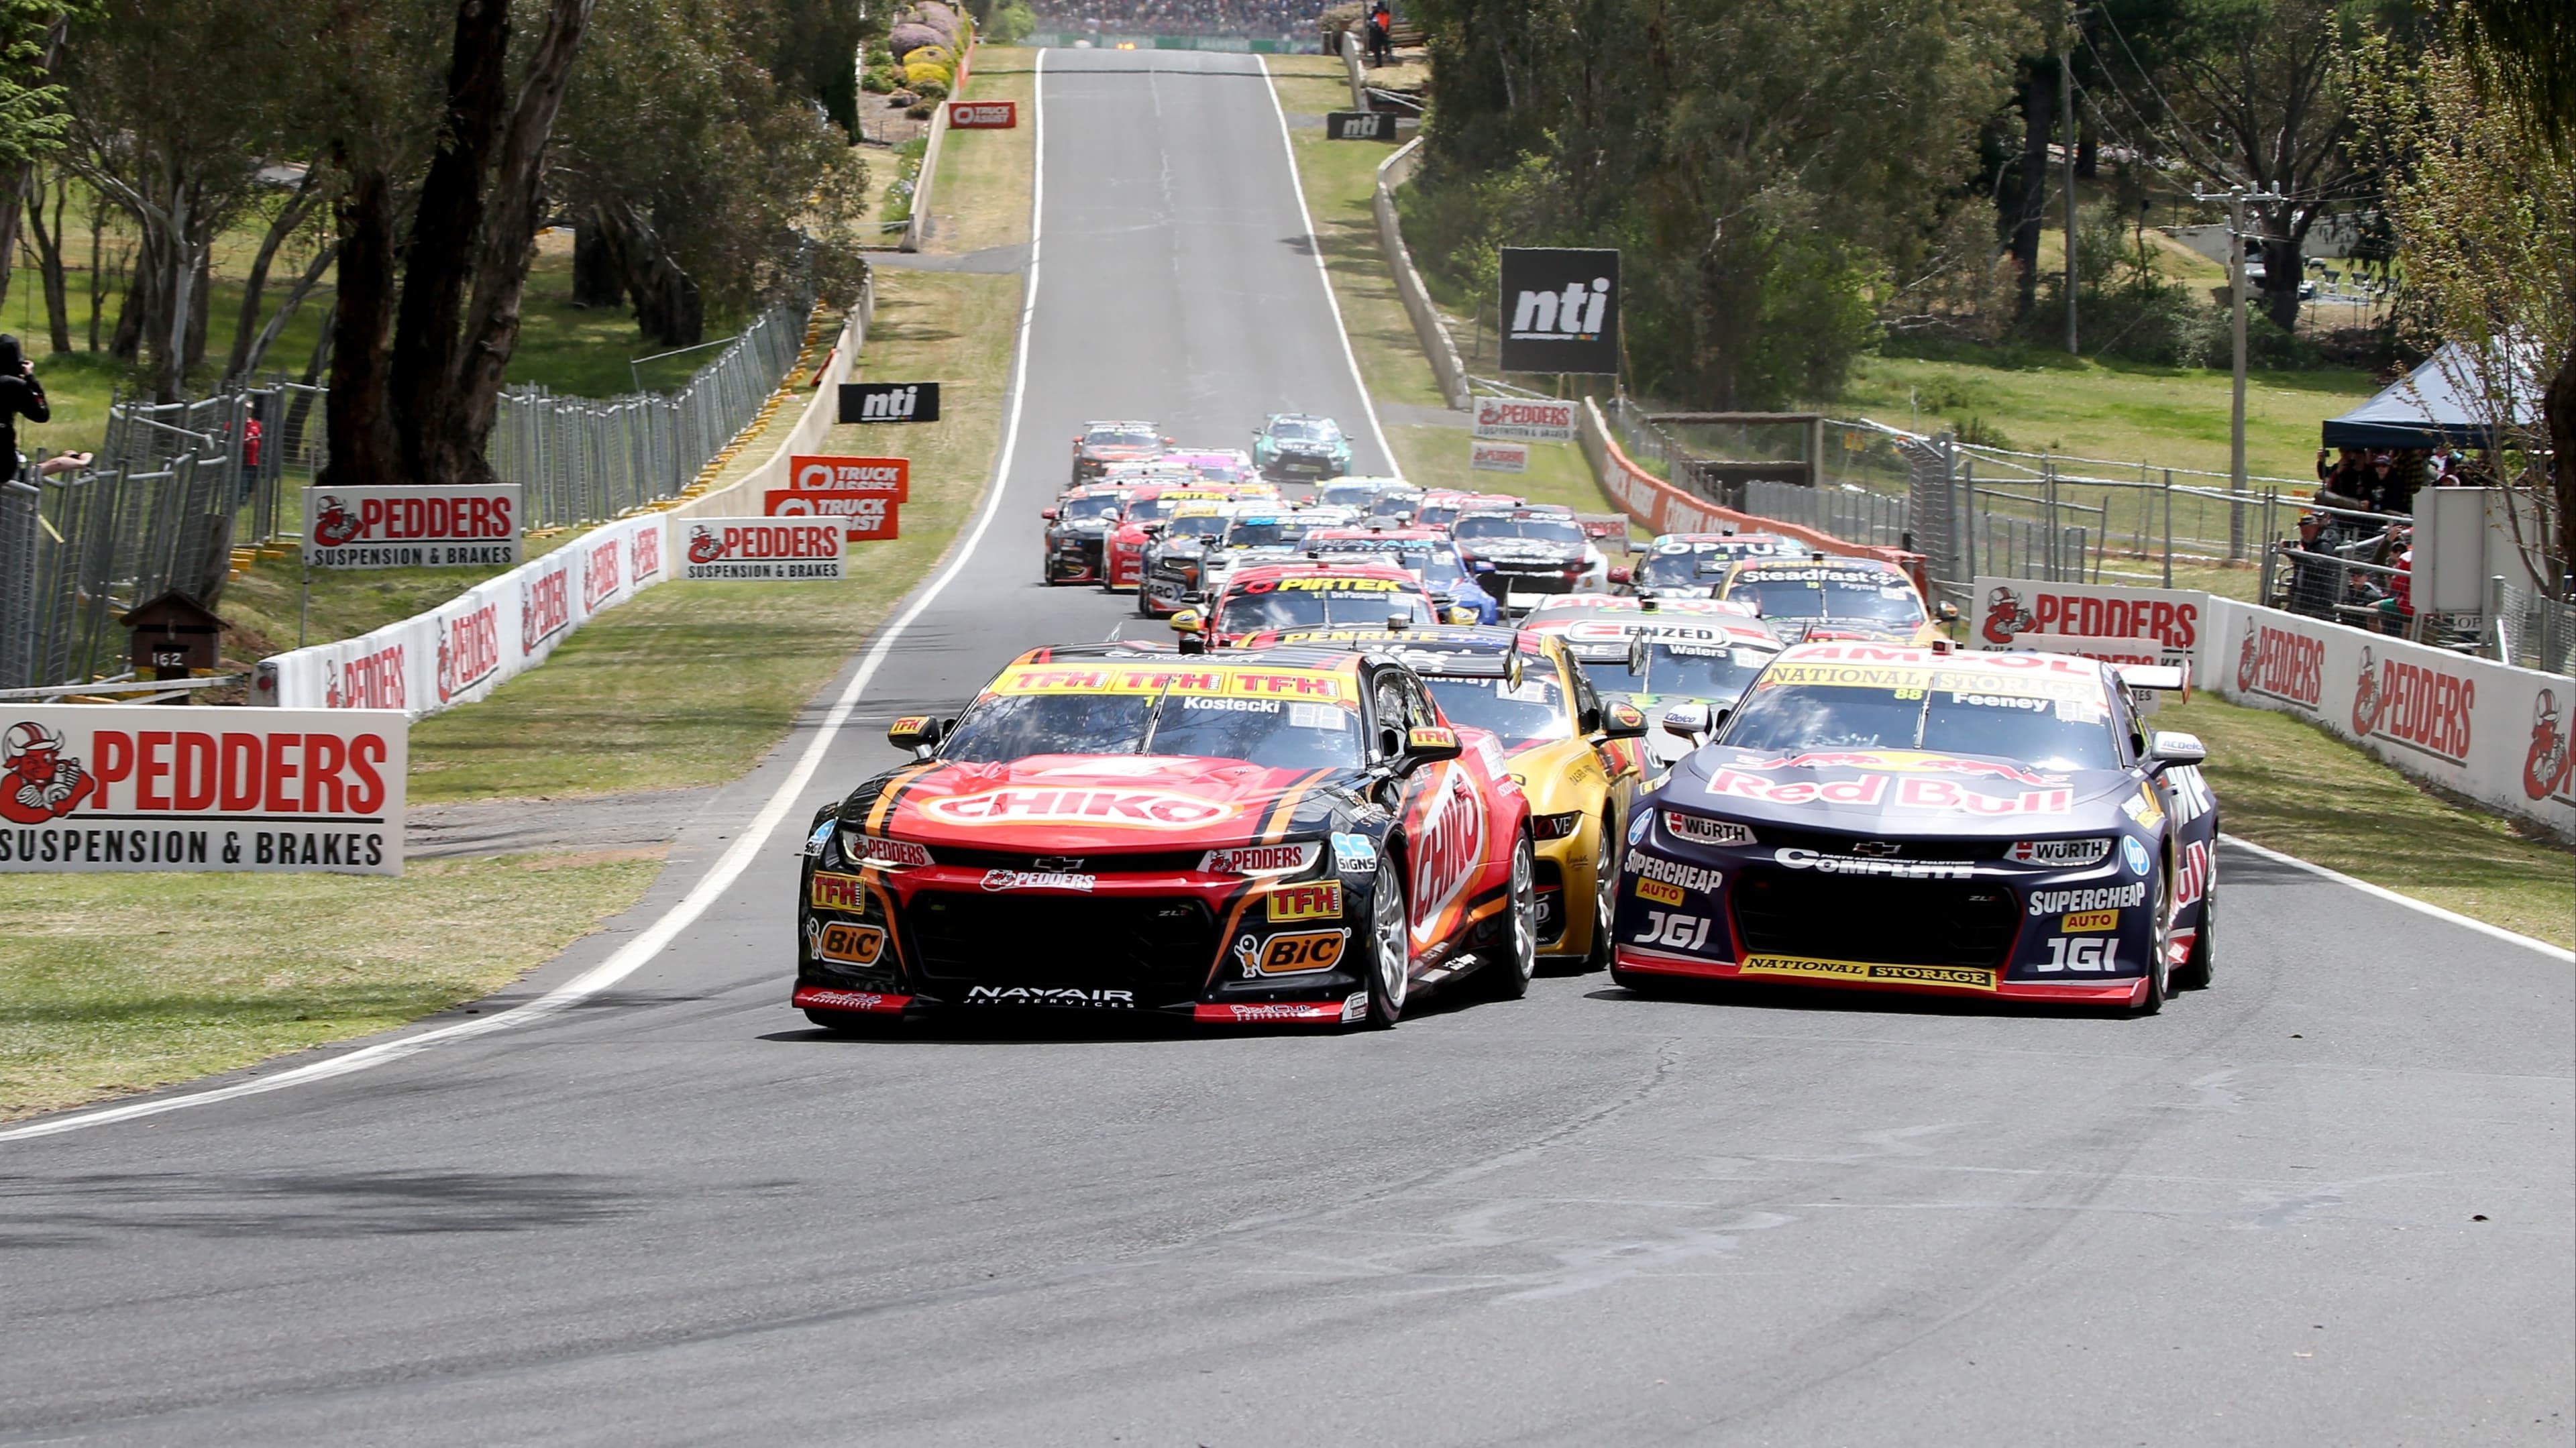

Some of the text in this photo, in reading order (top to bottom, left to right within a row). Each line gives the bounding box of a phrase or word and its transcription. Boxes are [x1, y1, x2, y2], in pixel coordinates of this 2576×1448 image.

[1343, 115, 1380, 135] nti
[1511, 277, 1610, 333] nti
[863, 386, 918, 416] nti
[1501, 404, 1570, 425] PEDDERS
[837, 466, 900, 480] TRUCK
[818, 499, 888, 514] TRUCK
[361, 496, 512, 539] PEDDERS
[723, 526, 838, 557] PEDDERS
[1659, 543, 1803, 556] OPTUS
[314, 546, 512, 567] SUSPENSION & BRAKES
[688, 563, 839, 578] SUSPENSION & BRAKES
[1744, 569, 1868, 583] Steadfast
[1278, 578, 1404, 592] PIRTEK
[1839, 582, 1877, 592] Payne
[1552, 598, 1743, 614] AMOL
[2034, 593, 2198, 649] PEDDERS
[1283, 630, 1440, 645] PENRITE
[1623, 625, 1713, 639] ENZED
[152, 652, 183, 667] 162
[1669, 644, 1727, 657] Waters
[2255, 625, 2324, 706] PEDDERS
[1018, 671, 1100, 689] TFH
[1118, 672, 1214, 690] TFH
[1236, 674, 1328, 696] TFH
[1770, 667, 2090, 700] NATIONAL STORAGE
[1143, 696, 1155, 708] 1
[1894, 689, 1923, 700] 88
[1952, 692, 2049, 712] Feeney
[1183, 696, 1280, 714] Kostecki
[2377, 659, 2475, 760] PEDDERS
[893, 720, 920, 731] TFH
[1412, 730, 1448, 742] TFH
[91, 730, 386, 815] PEDDERS
[1707, 768, 2071, 814] Red Bull
[939, 791, 1220, 823] CHIKO
[0, 828, 382, 867] SUSPENSION & BRAKES
[867, 838, 925, 865] PEDDERS
[2128, 839, 2145, 873] hp
[1231, 846, 1302, 871] PEDDERS
[1412, 793, 1480, 929] CHIKO
[1014, 872, 1096, 889] PEDDERS
[1623, 848, 1723, 895] SUPERCHEAP
[814, 877, 857, 905] TFH
[1274, 887, 1334, 914] TFH
[1640, 881, 1680, 901] AUTO
[2029, 881, 2146, 916] SUPERCHEAP
[1633, 911, 1712, 950] JGI
[2067, 914, 2111, 928] AUTO
[2037, 938, 2121, 972] JGI
[1747, 958, 1986, 984] NATIONAL STORAGE
[968, 986, 1134, 1001] NAVAIR
[1018, 999, 1134, 1008] SERVICES
